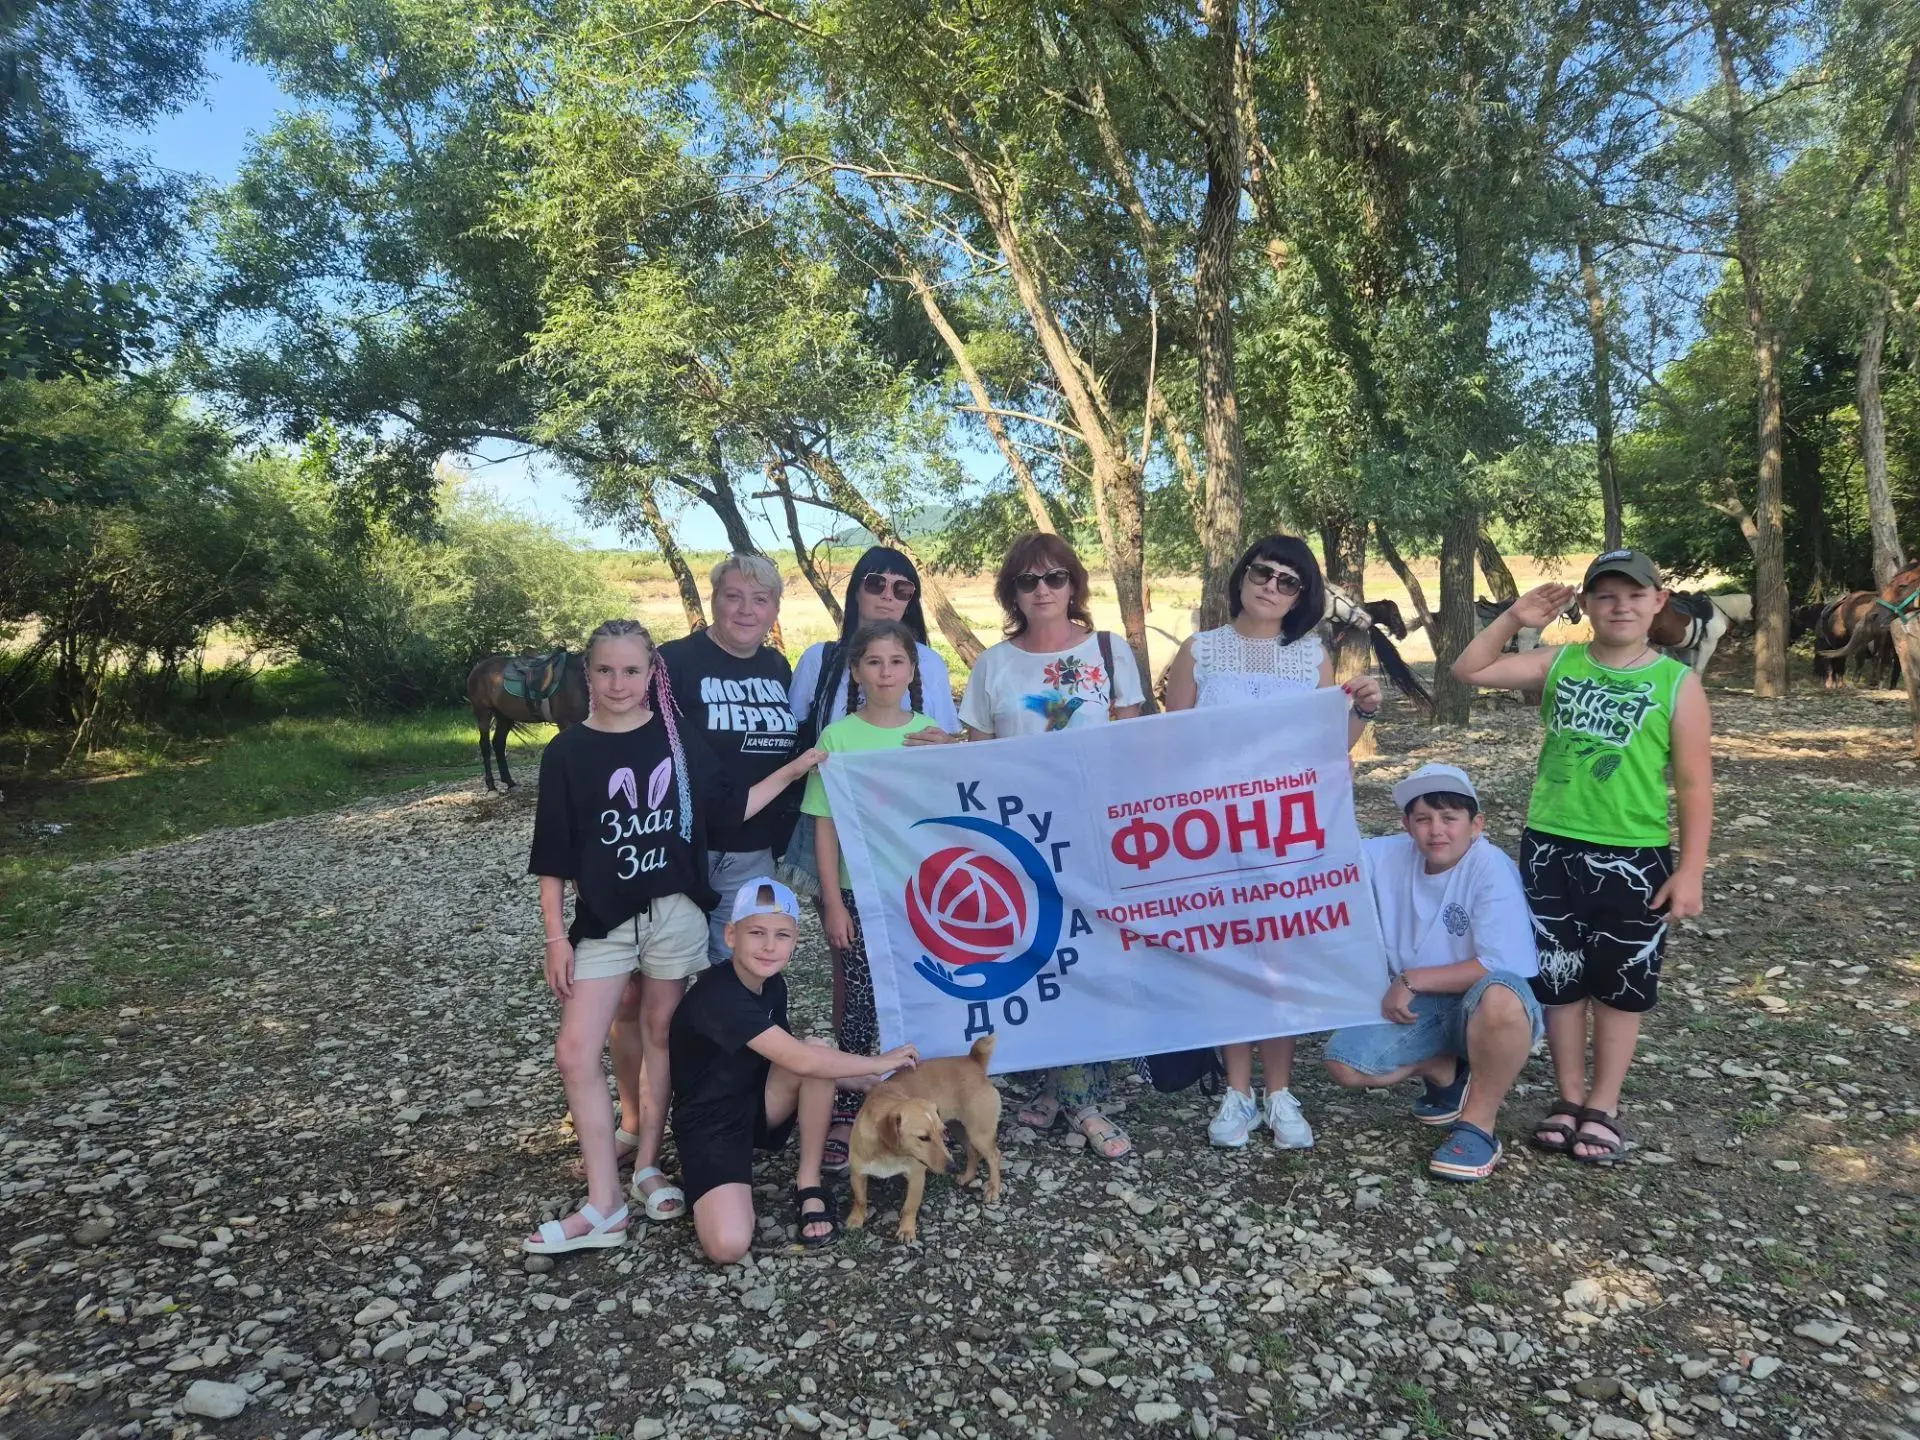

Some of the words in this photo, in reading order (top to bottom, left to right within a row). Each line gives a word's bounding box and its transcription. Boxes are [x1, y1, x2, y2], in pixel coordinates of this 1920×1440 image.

[1555, 676, 1659, 729] Street
[747, 738, 795, 747] КАЧЕСТВЕН
[1107, 767, 1318, 820] БЛАГОТВОРИТЕЛЬНЫЙ
[956, 780, 1071, 874] КРУГ
[1111, 790, 1325, 871] ФОНД
[1232, 863, 1360, 904] НАРОДНОЙ
[964, 908, 1094, 1042] ДОБРА
